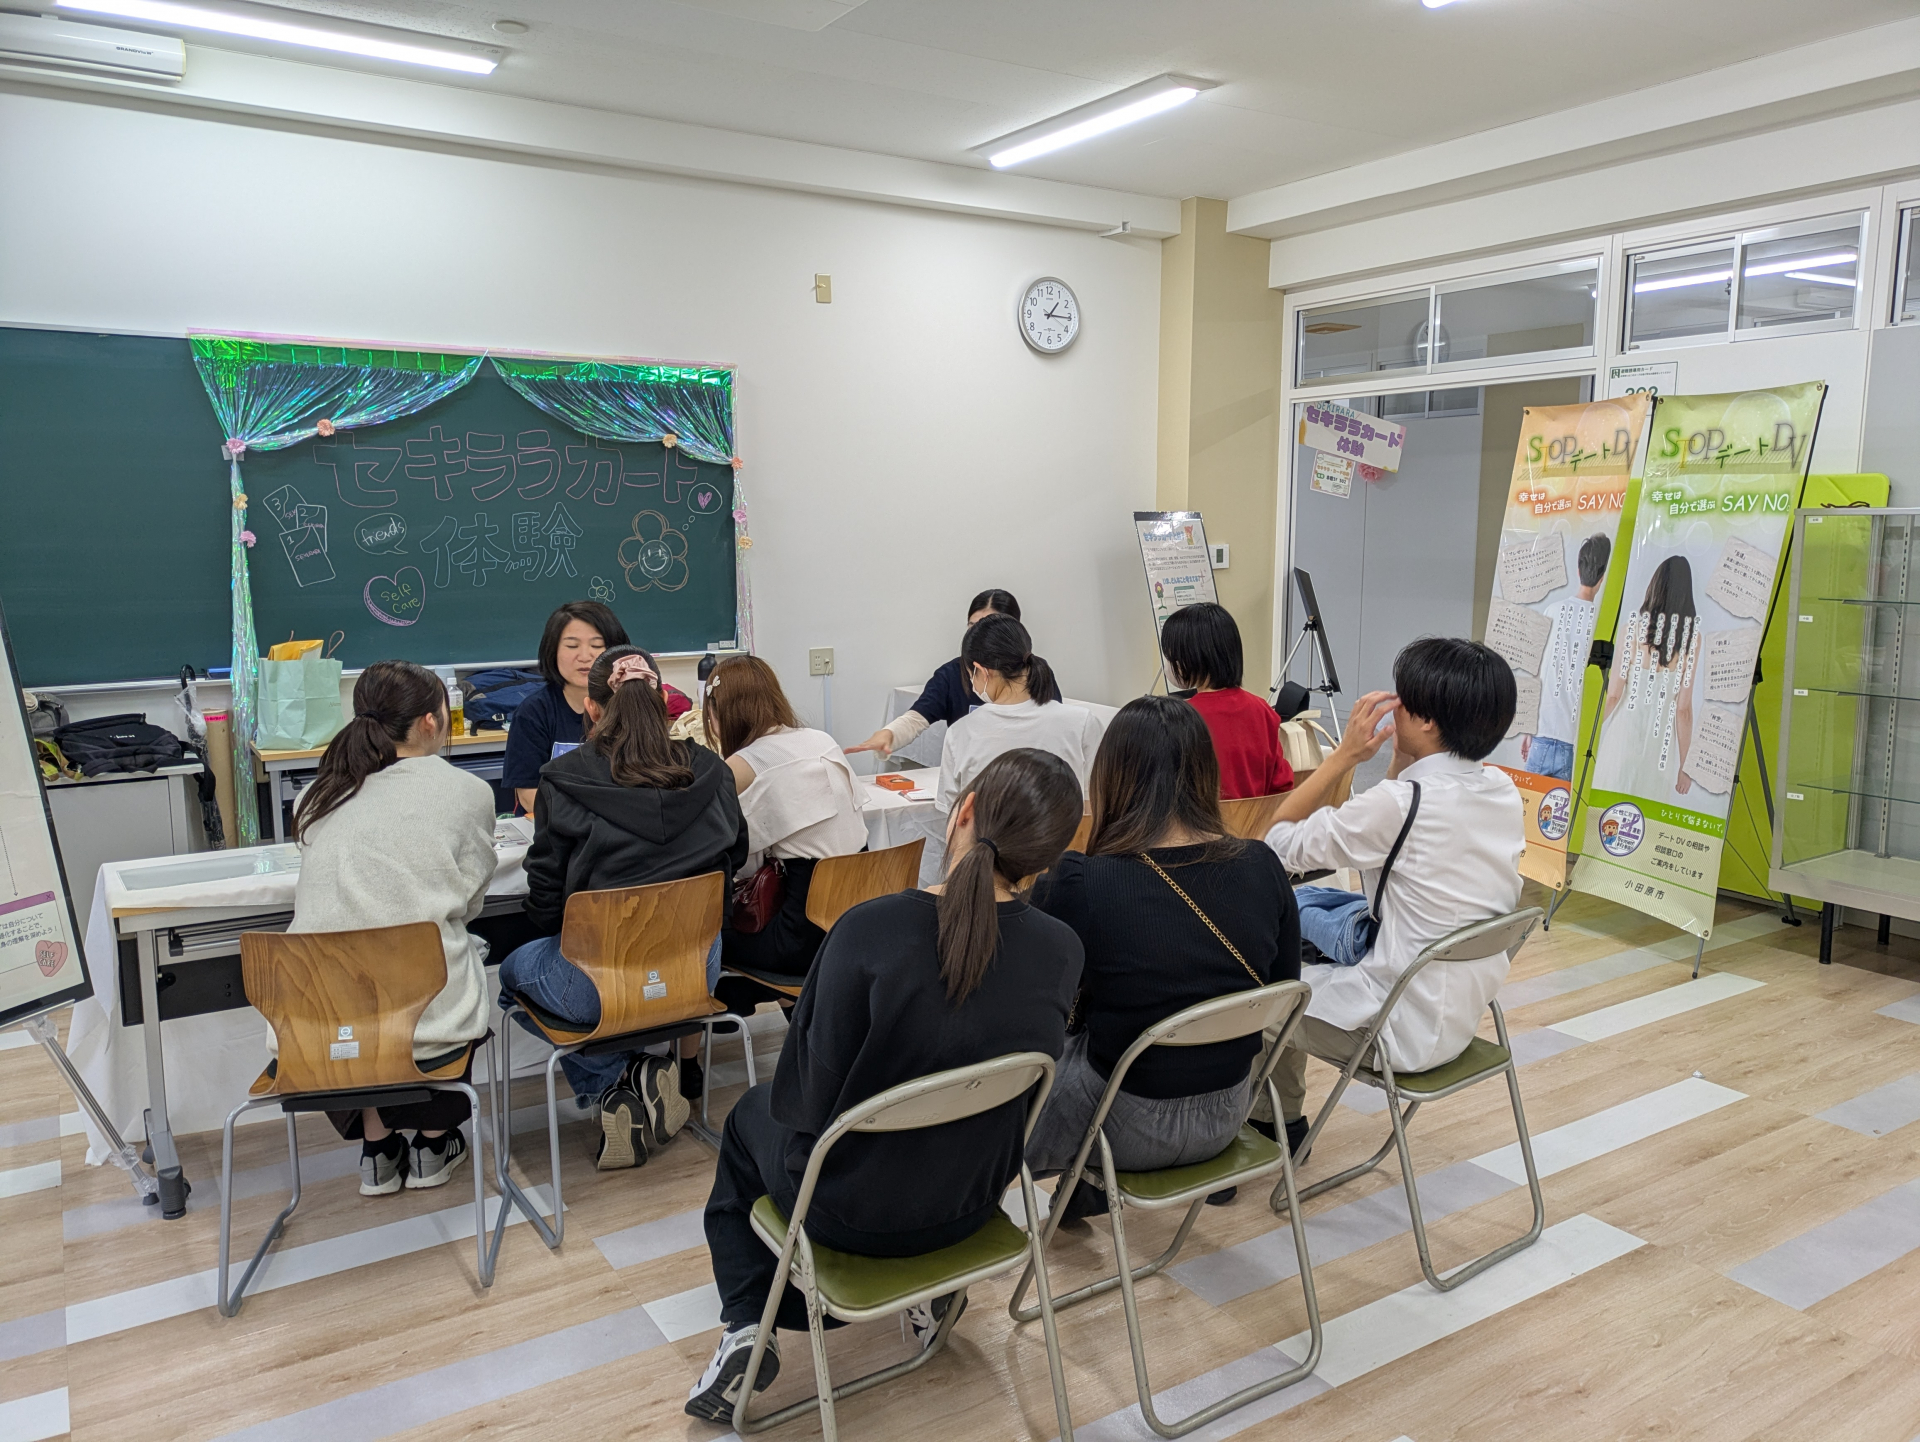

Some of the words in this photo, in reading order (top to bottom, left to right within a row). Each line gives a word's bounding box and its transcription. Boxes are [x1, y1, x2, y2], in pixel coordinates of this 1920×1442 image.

[1037, 289, 1043, 297] 11
[1046, 286, 1053, 295] 12
[1058, 290, 1060, 299] 1
[1030, 297, 1037, 306] 10
[1064, 300, 1069, 308] 2
[1027, 309, 1031, 318] 9
[1067, 313, 1071, 321] 3
[1030, 322, 1034, 331] 8
[1064, 325, 1068, 333] 4
[1038, 332, 1042, 340] 7
[1047, 336, 1052, 344] 6
[1057, 334, 1061, 342] 5
[1316, 401, 1355, 419] SEKIRARA
[1306, 405, 1403, 448] セキララカード
[1337, 436, 1365, 458] 体験
[1519, 492, 1545, 502] 幸せは
[1651, 491, 1681, 502] 幸せは
[272, 498, 281, 510] 3
[1535, 499, 1572, 514] 自分で選ぶ
[1578, 493, 1606, 510] SAY
[1669, 499, 1715, 515] 自分で選ぶ
[1722, 494, 1758, 512] SAY
[300, 508, 308, 517] 2
[361, 517, 405, 546] friends
[287, 536, 294, 545] 1
[420, 502, 583, 588] 体験
[1639, 613, 1650, 642] あなたの
[1621, 612, 1636, 678] あなたのものだから
[1628, 651, 1643, 710] ココロとカラダは
[1661, 809, 1723, 834] ひとりで悩まないで。
[1654, 844, 1683, 859] 相談窓口の
[1650, 857, 1703, 879] ご案内をしています
[1624, 880, 1665, 900] 小田原市
[0, 913, 43, 930] は自分について
[40, 951, 55, 959] SELF
[40, 959, 55, 967] CARE
